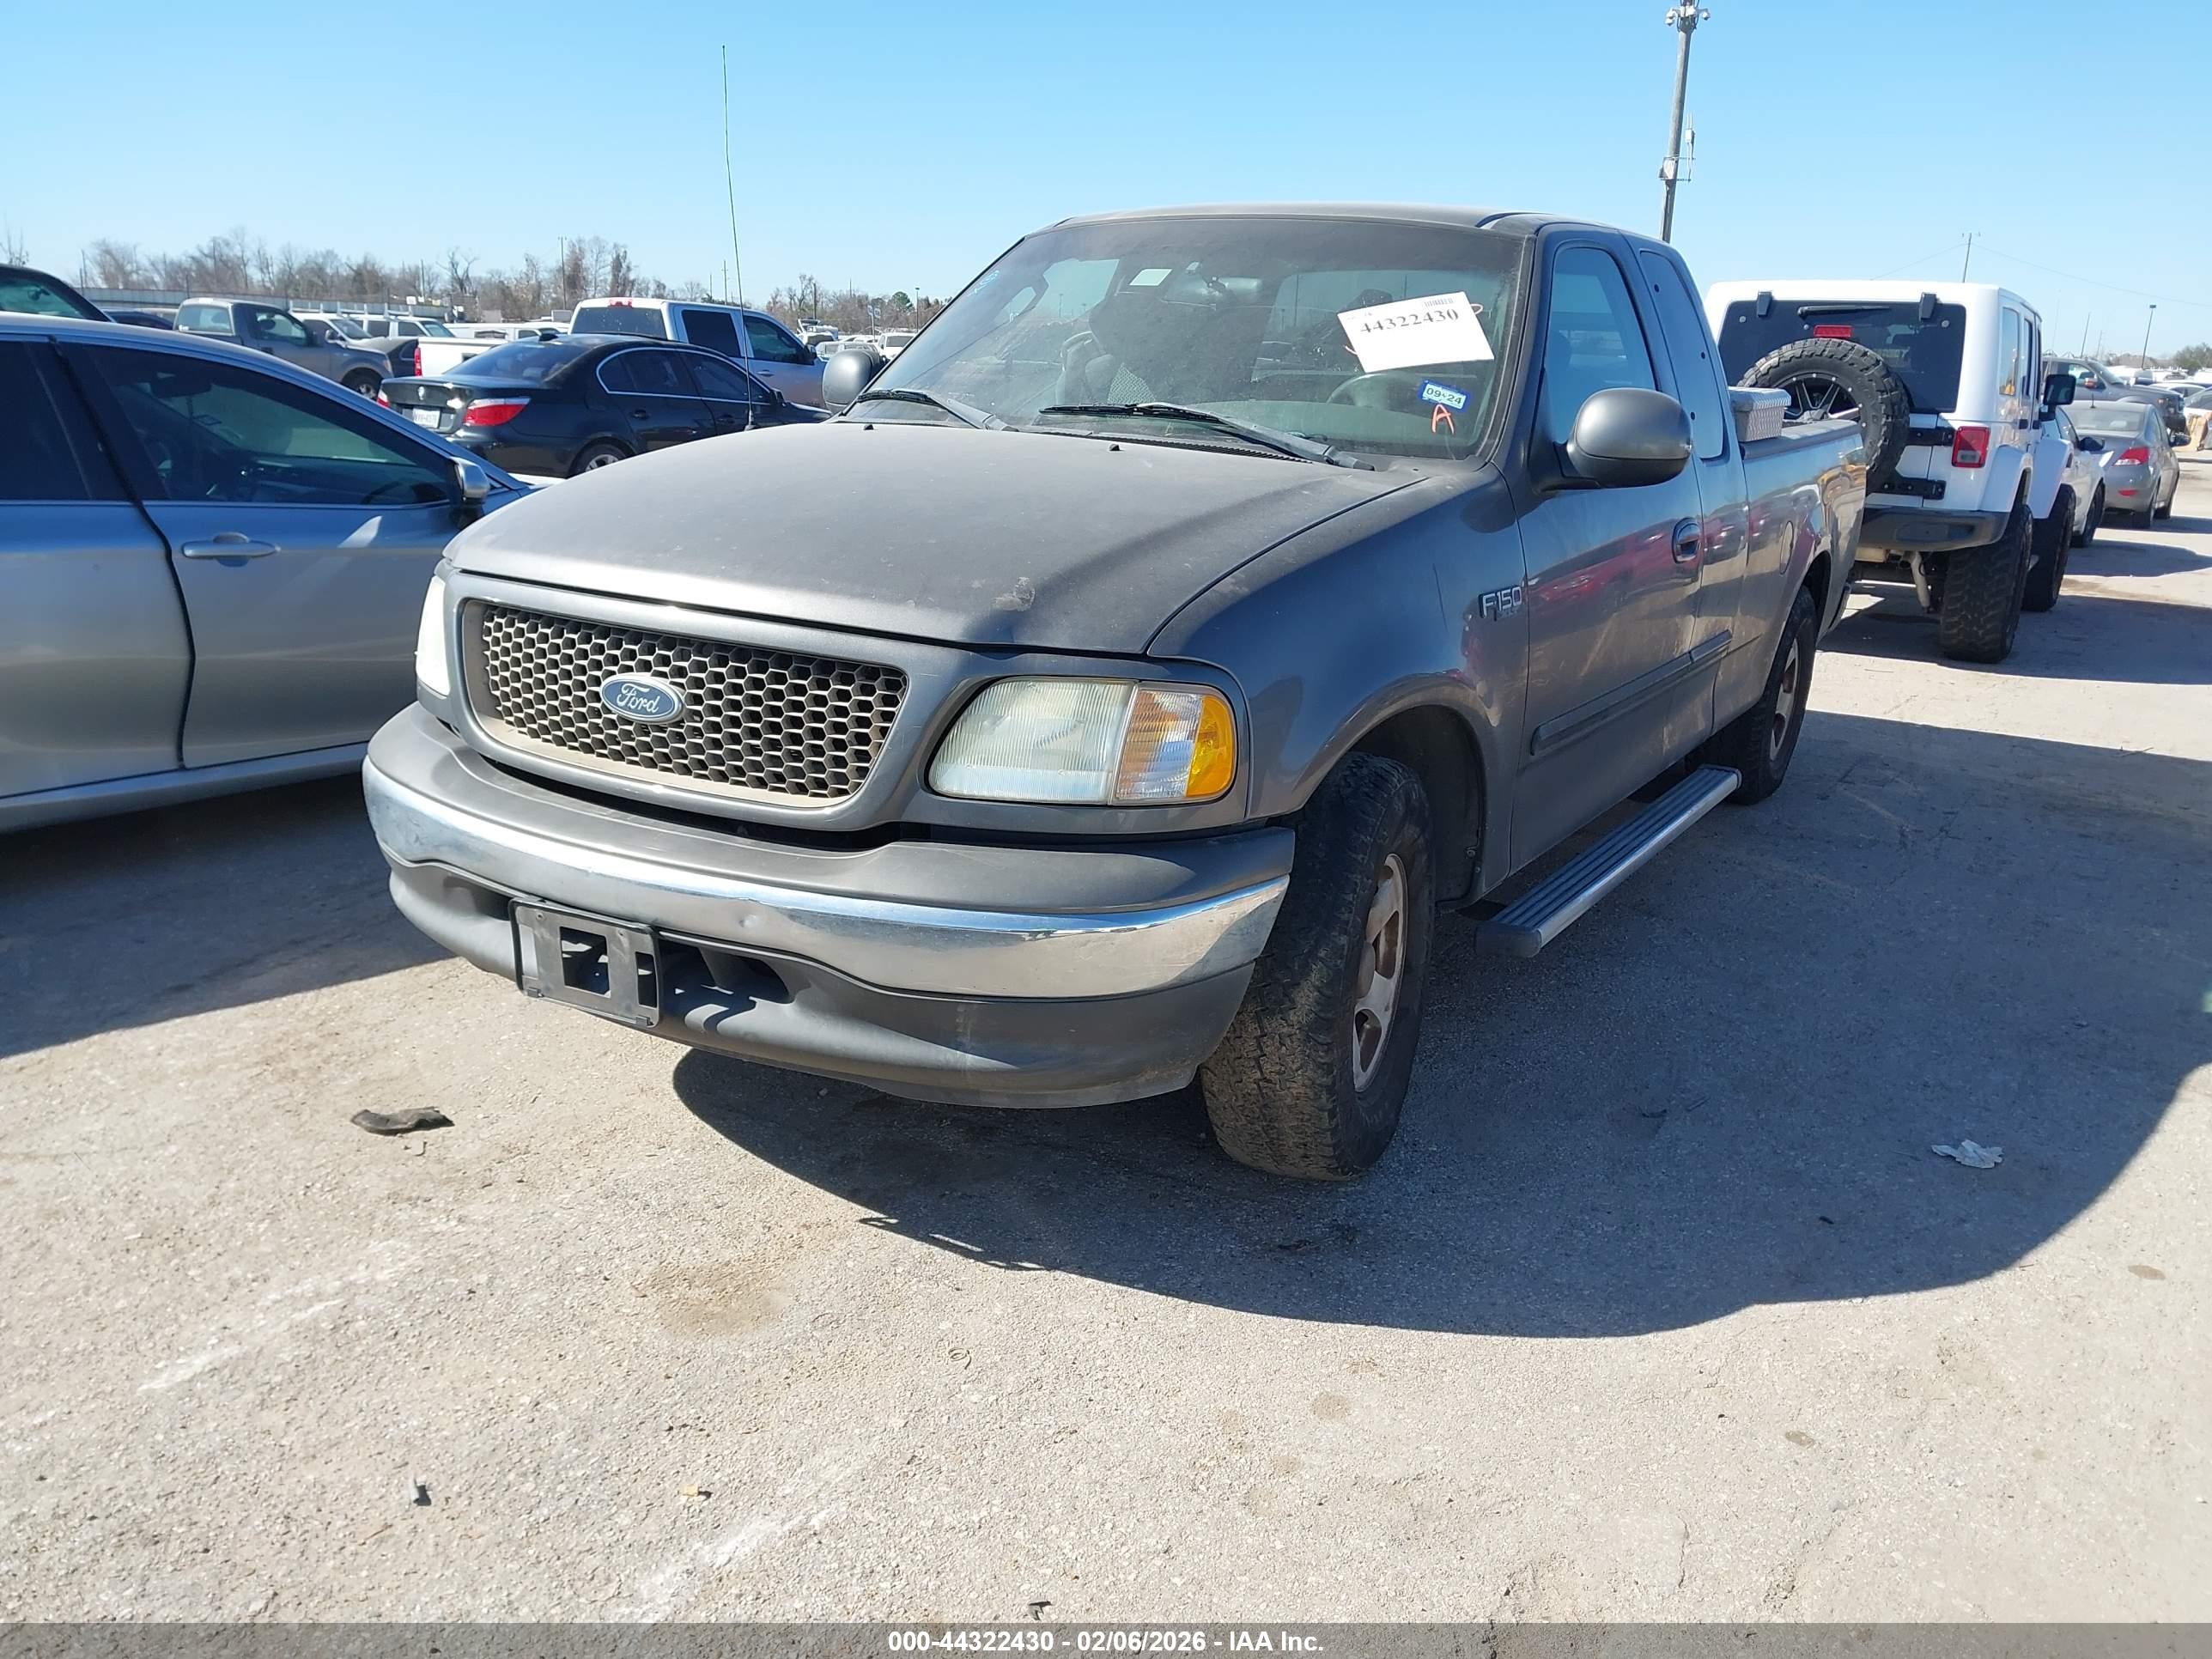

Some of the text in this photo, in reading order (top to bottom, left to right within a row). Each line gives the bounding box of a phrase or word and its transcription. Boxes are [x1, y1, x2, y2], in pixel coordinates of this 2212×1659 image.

[1360, 308, 1459, 333] 44322430
[1431, 404, 1455, 435] A
[617, 683, 660, 714] Ford
